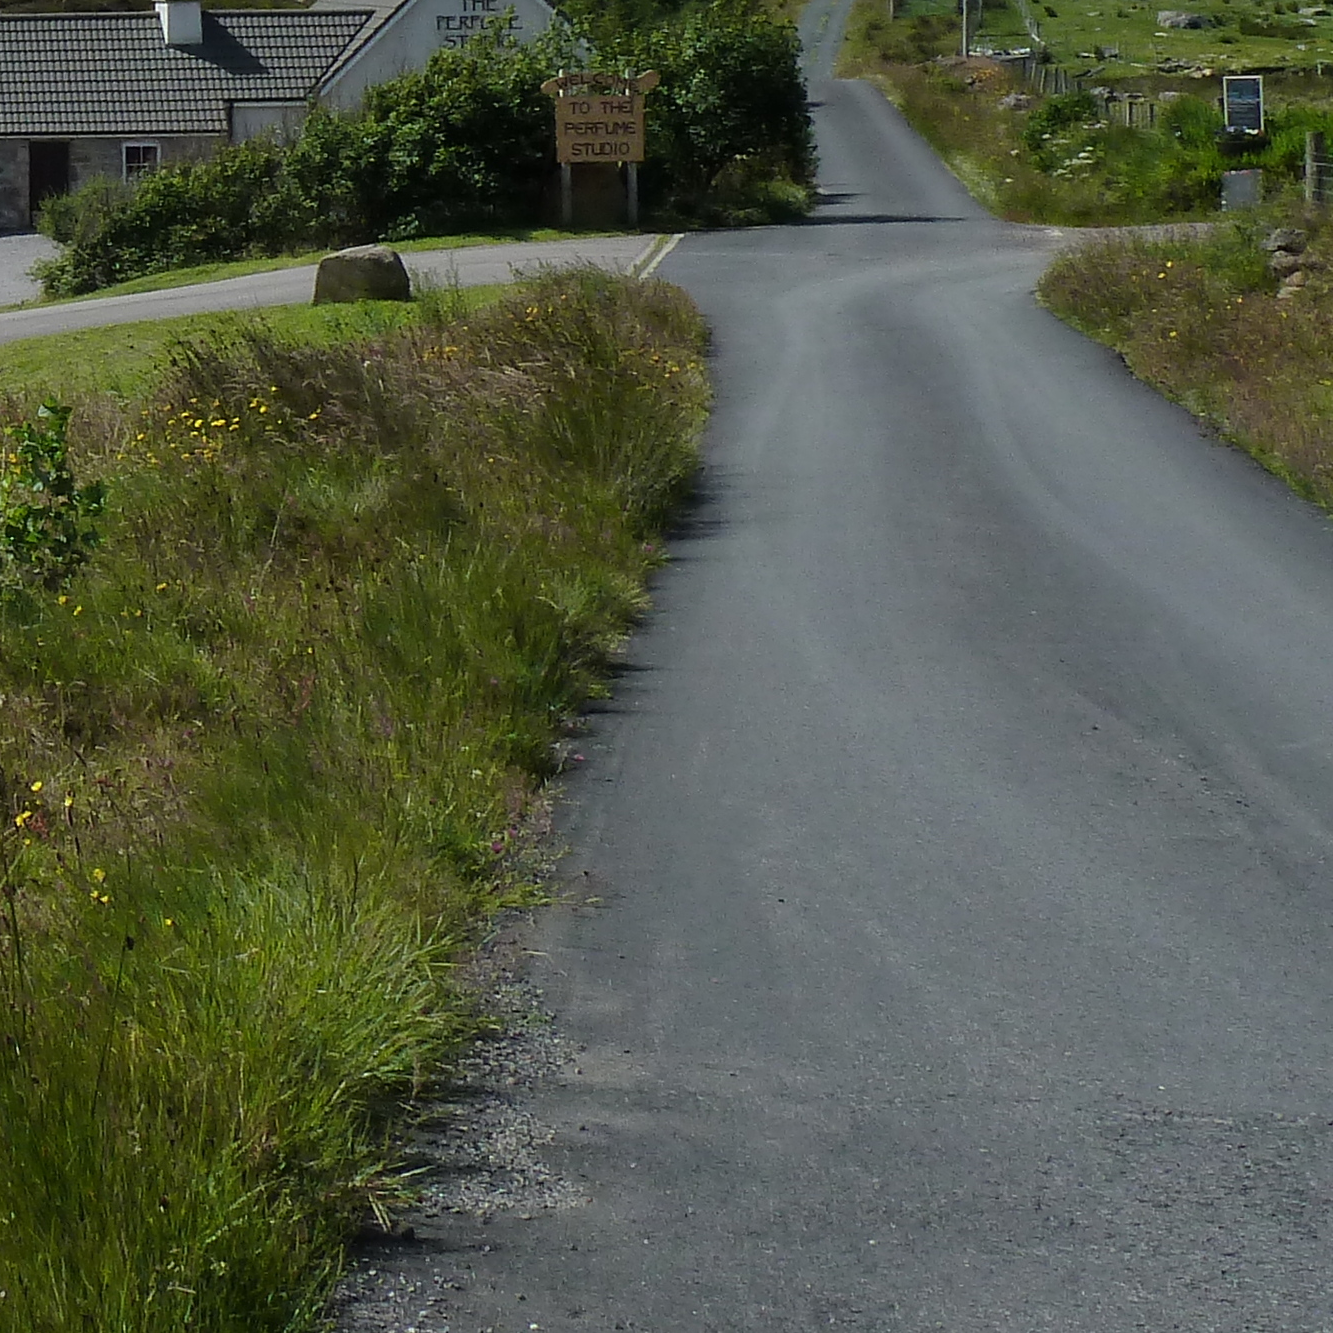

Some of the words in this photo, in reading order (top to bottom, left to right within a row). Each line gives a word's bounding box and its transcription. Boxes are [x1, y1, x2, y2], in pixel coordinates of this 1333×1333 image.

[436, 15, 523, 31] PERFUE
[556, 73, 640, 93] WELCOME
[569, 101, 590, 115] TO
[600, 101, 633, 115] THE
[564, 122, 636, 136] PERFUME
[571, 141, 630, 157] STUDIO
